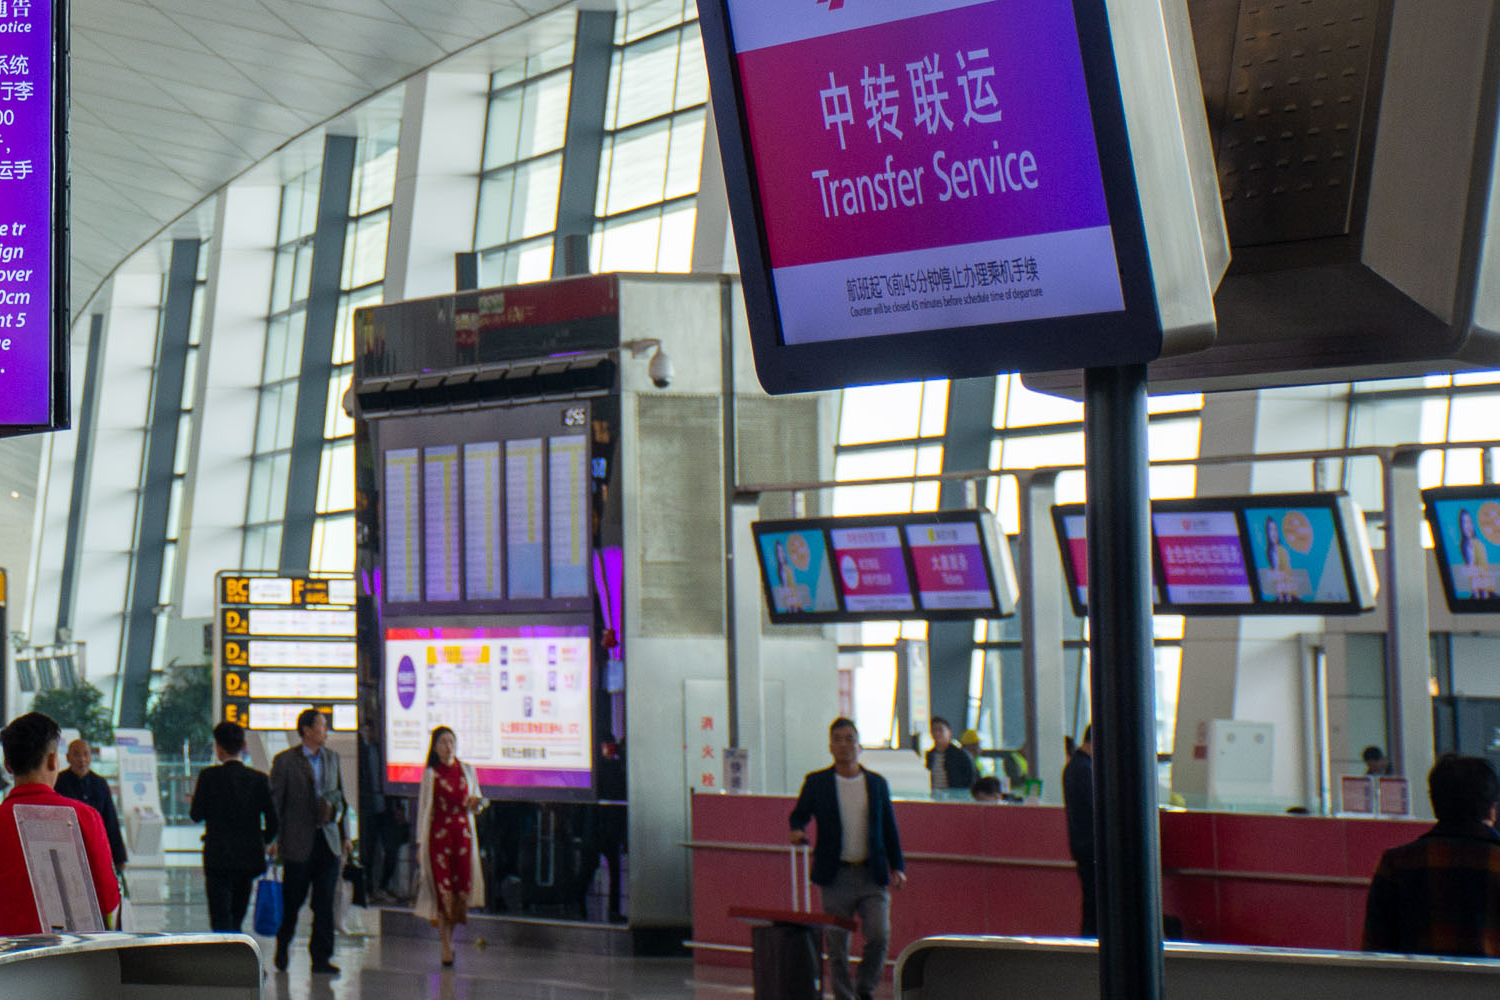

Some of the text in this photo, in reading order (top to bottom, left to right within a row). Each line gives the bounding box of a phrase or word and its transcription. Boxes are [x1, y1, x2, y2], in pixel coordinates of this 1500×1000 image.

[820, 48, 1002, 150] 中转联运
[812, 140, 1039, 218] Transfer Service
[12, 222, 26, 236] tr
[846, 256, 1040, 302] 航班起飞前45分钟停止办理乘机手续
[16, 312, 26, 327] 5
[851, 306, 872, 317] Counter
[892, 302, 911, 313] closed
[911, 300, 919, 311] 45
[942, 295, 963, 307] before
[990, 291, 1005, 302] time
[1012, 287, 1043, 301] departure
